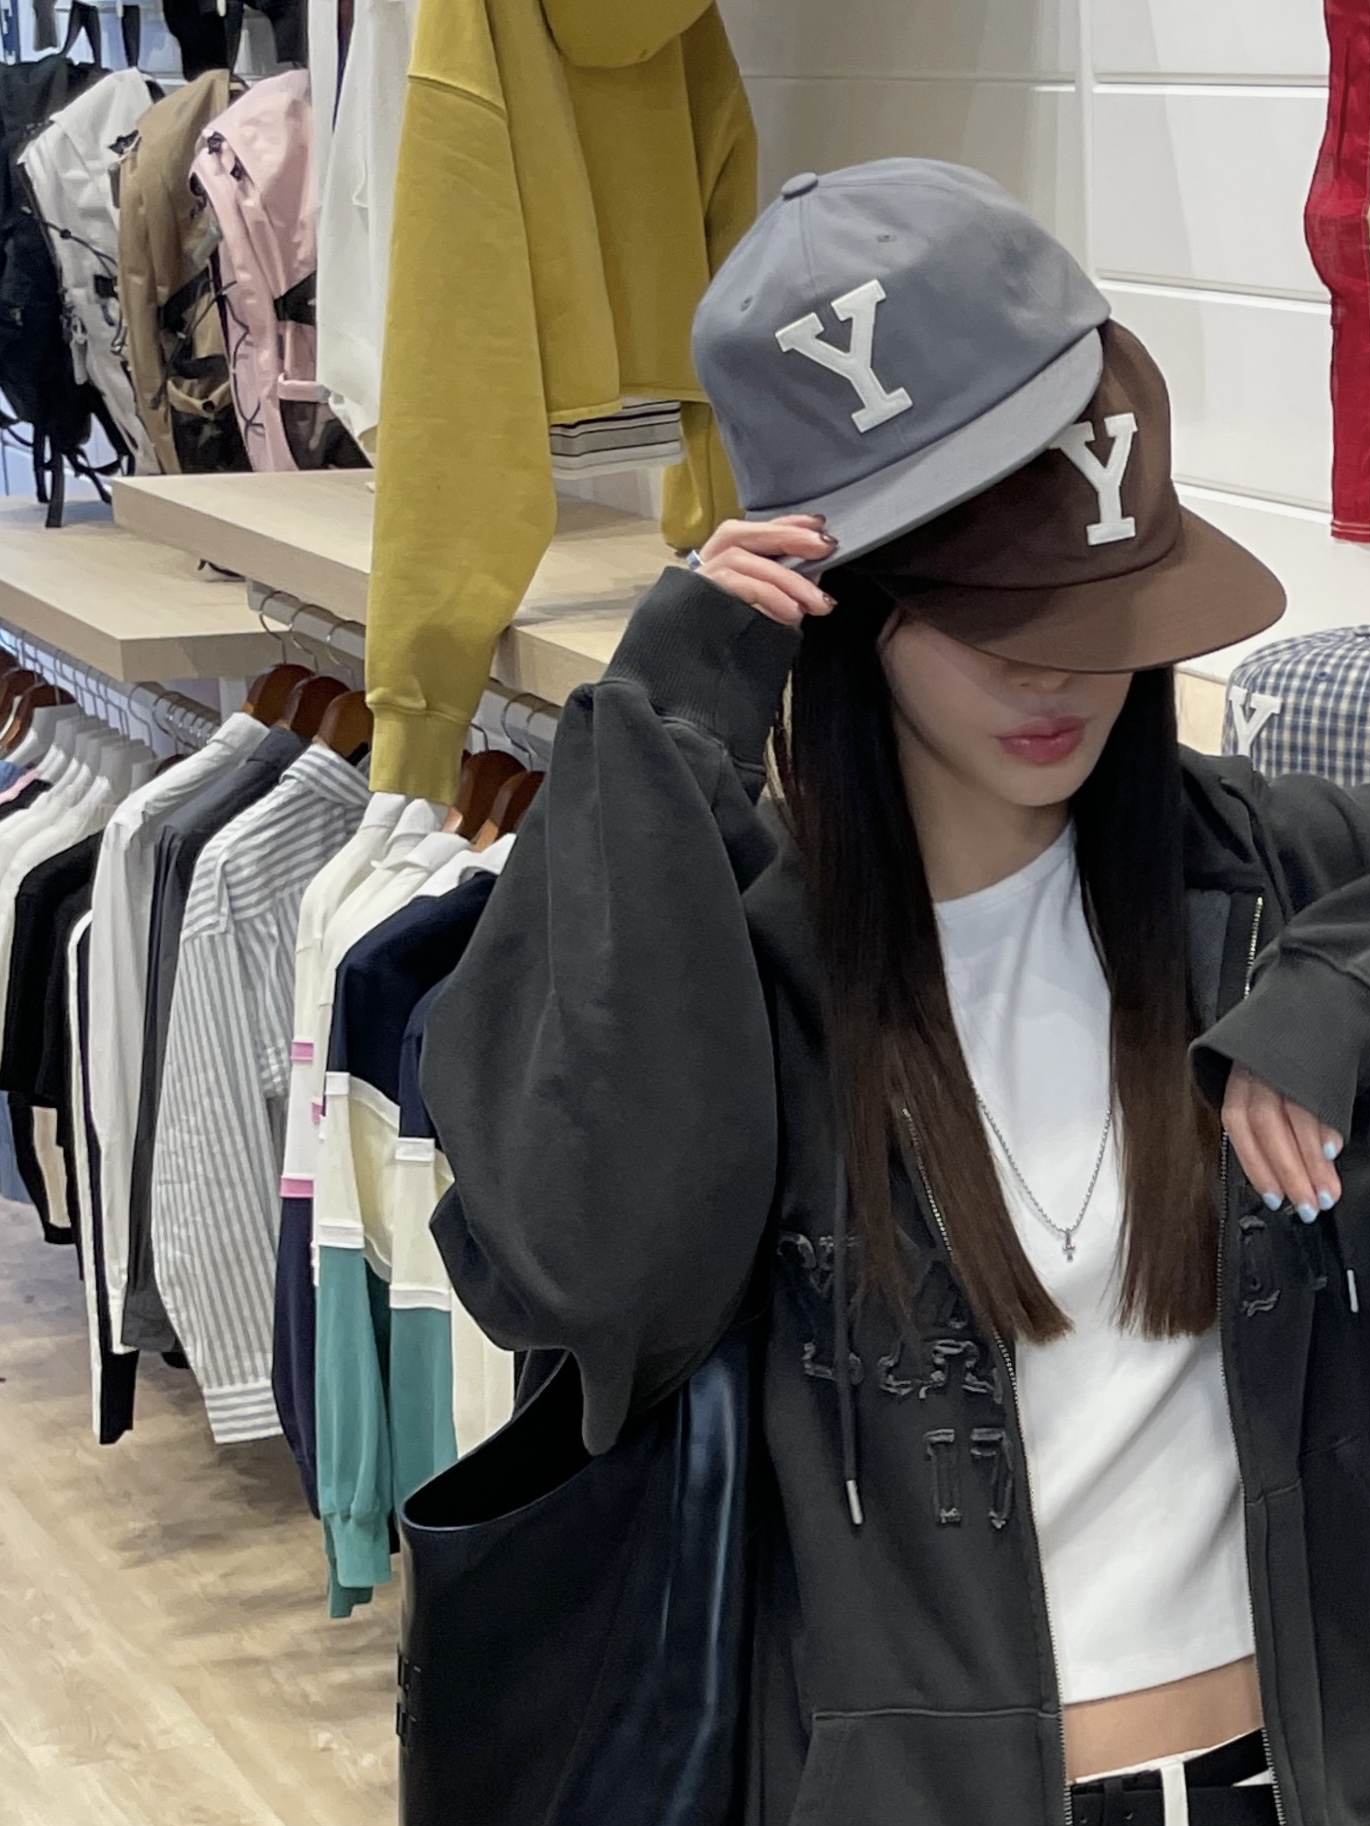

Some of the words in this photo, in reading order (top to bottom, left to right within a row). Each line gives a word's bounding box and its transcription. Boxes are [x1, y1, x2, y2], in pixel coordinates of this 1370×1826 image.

[775, 279, 914, 434] Y
[1050, 412, 1139, 546] Y
[1228, 684, 1284, 757] Y
